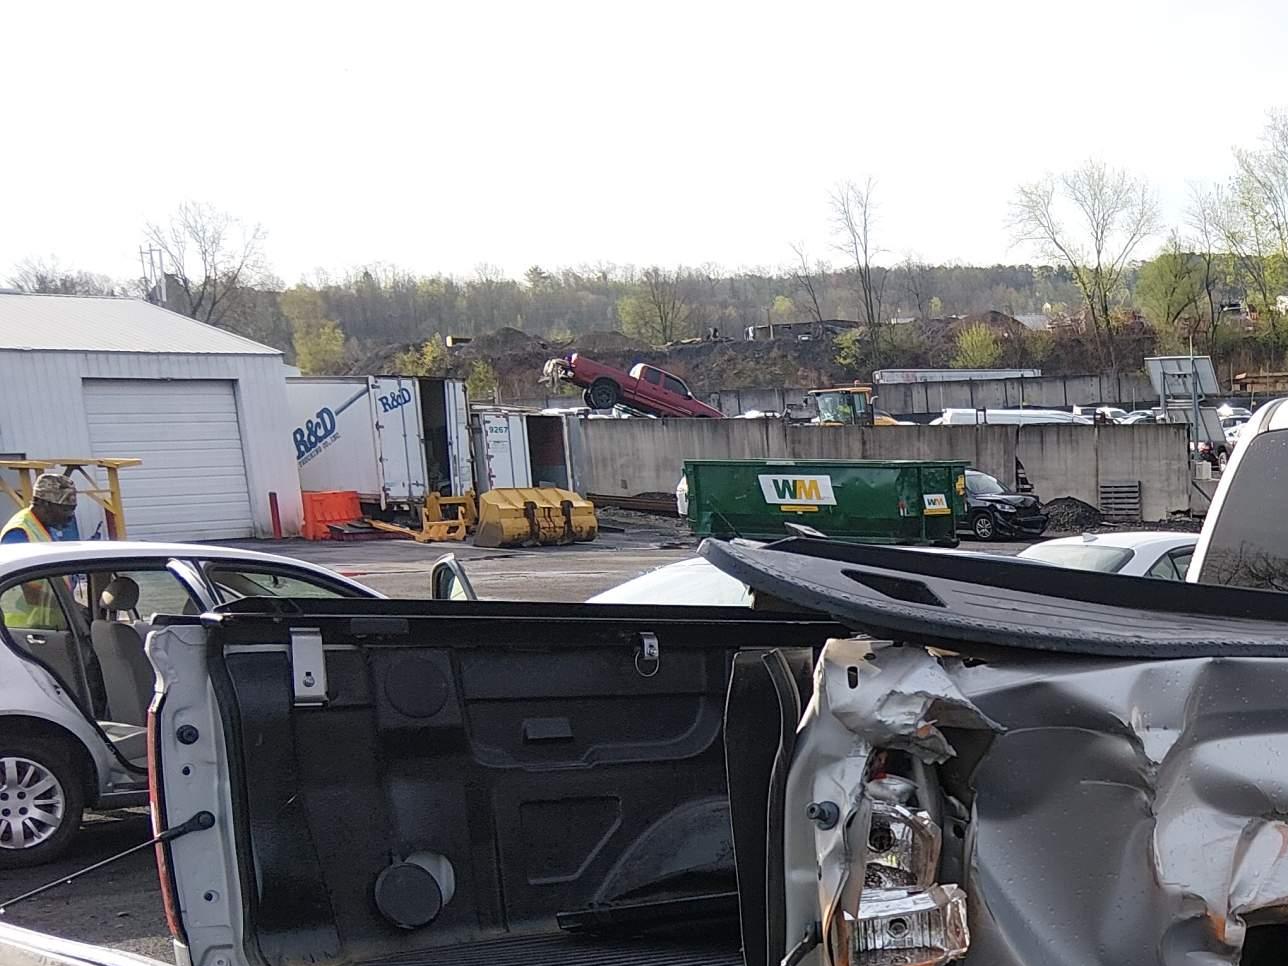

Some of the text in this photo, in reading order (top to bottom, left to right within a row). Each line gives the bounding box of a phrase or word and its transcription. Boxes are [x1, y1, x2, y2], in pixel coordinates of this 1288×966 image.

[378, 388, 411, 413] R&D
[292, 407, 336, 460] R&D
[772, 479, 822, 500] WM
[927, 497, 945, 506] WM
